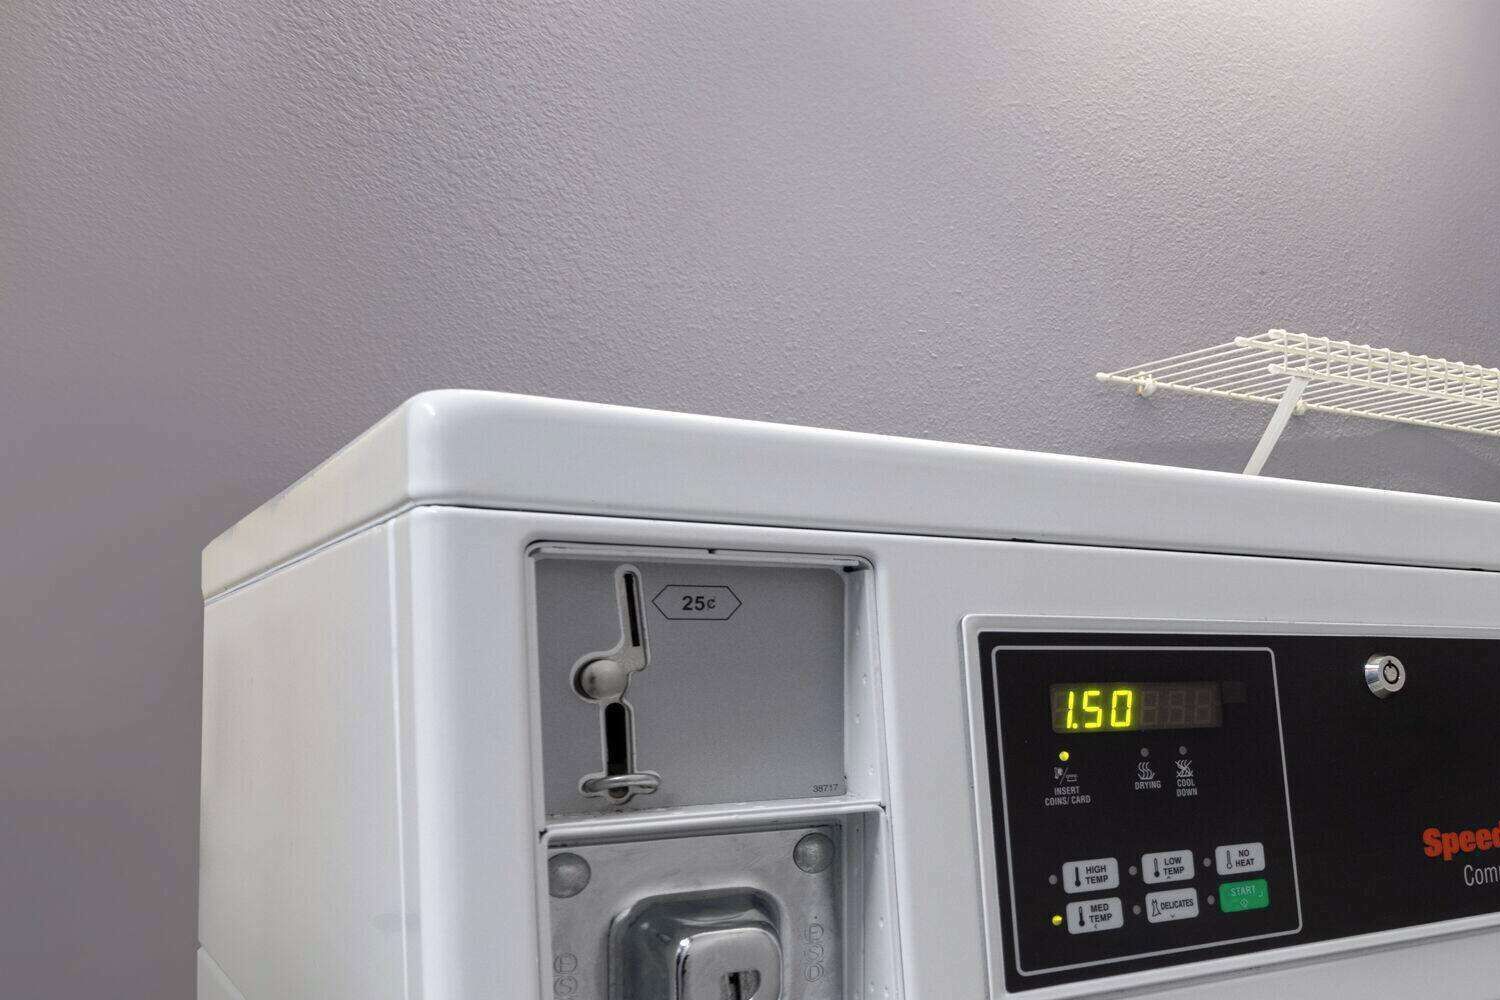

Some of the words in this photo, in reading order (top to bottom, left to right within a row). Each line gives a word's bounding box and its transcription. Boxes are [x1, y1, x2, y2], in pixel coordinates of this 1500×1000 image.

[1066, 690, 1133, 729] 1.50
[1135, 780, 1162, 791] DRYING
[1176, 778, 1195, 787] COOL
[1054, 785, 1080, 795] INSERT
[1176, 788, 1198, 797] DOWN
[1238, 849, 1250, 858] NO
[1164, 856, 1182, 866] LOW
[1235, 858, 1256, 868] HEAT
[1085, 864, 1107, 875] HIGH
[1163, 866, 1185, 876] TEMP
[1085, 875, 1109, 885] TEMP
[1230, 885, 1256, 897] START
[1090, 903, 1109, 913] MED
[1160, 898, 1194, 911] DELICATES
[1088, 913, 1113, 923] TEMP
